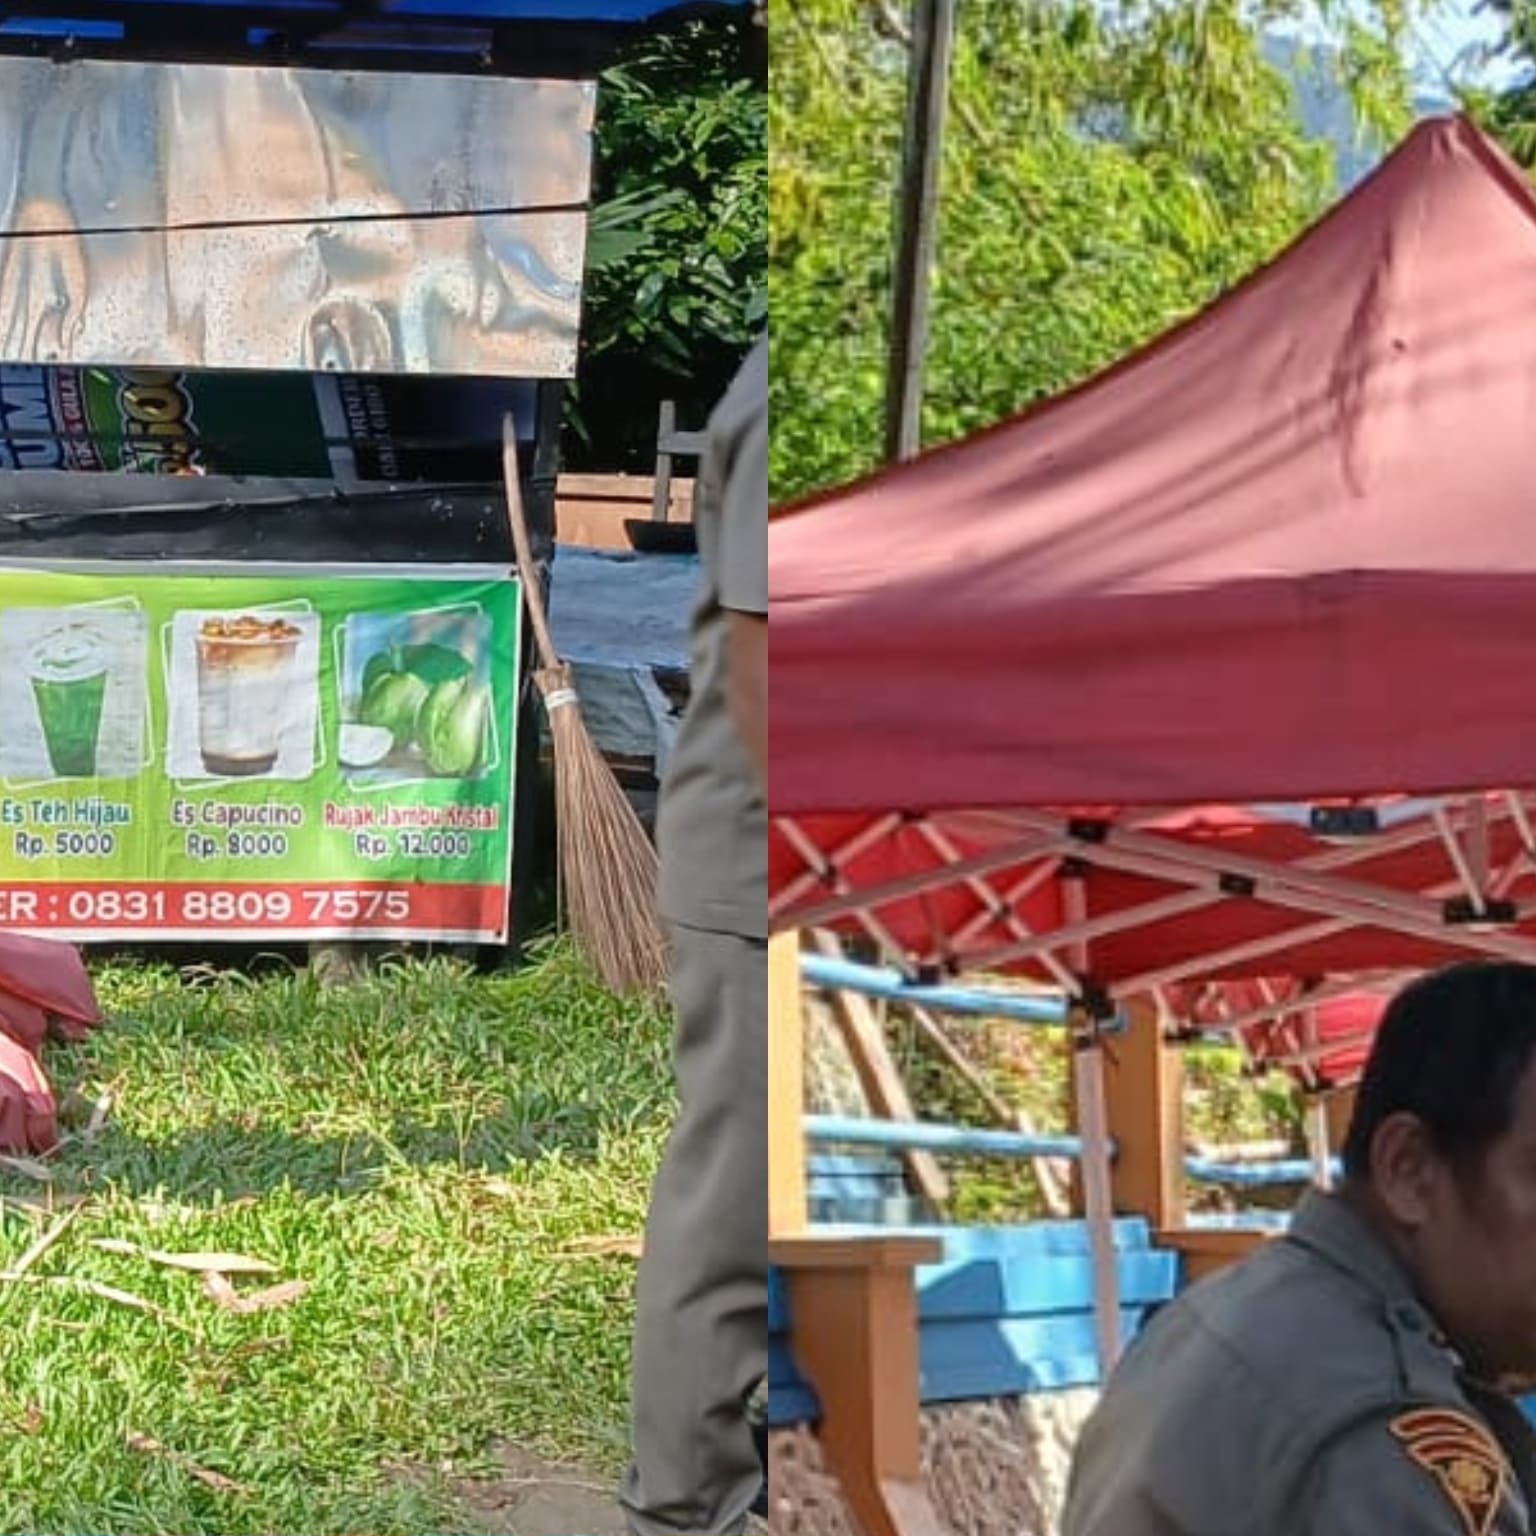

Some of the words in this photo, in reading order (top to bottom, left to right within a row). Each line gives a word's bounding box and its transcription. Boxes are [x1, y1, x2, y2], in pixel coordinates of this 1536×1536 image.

[2, 800, 24, 823] Es
[32, 800, 68, 823] Teh
[75, 799, 130, 827] Hijau
[174, 801, 195, 824] Es
[202, 801, 302, 828] Capucino
[325, 802, 374, 829] Rujak
[380, 804, 441, 826] Jambu
[56, 833, 113, 853] 5000
[228, 833, 287, 854] 8000
[68, 889, 165, 921] 0831
[181, 889, 292, 922] 8809
[302, 890, 409, 921] 7575
